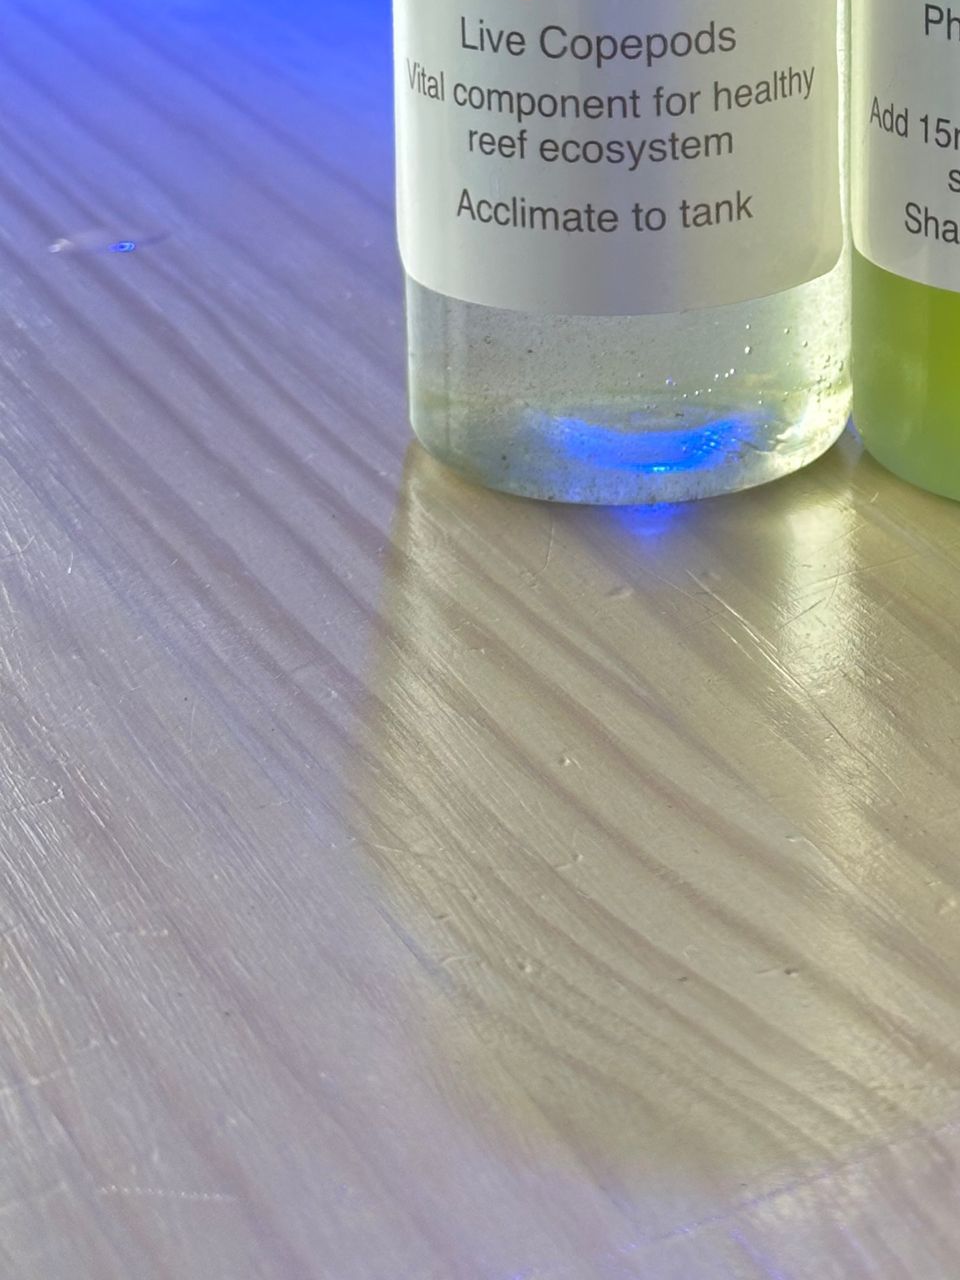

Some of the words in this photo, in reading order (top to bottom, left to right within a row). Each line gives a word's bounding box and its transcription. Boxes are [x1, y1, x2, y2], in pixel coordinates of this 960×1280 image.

[460, 16, 526, 57] Live
[539, 21, 737, 68] Copepods
[406, 58, 445, 102] Vital
[453, 78, 640, 123] component
[653, 86, 701, 118] for
[713, 67, 815, 112] healthy
[870, 96, 909, 138] Add
[468, 128, 527, 161] reef
[539, 130, 734, 171] ecosystem
[457, 188, 619, 233] Acclimate
[631, 200, 666, 232] to
[679, 191, 754, 229] tank
